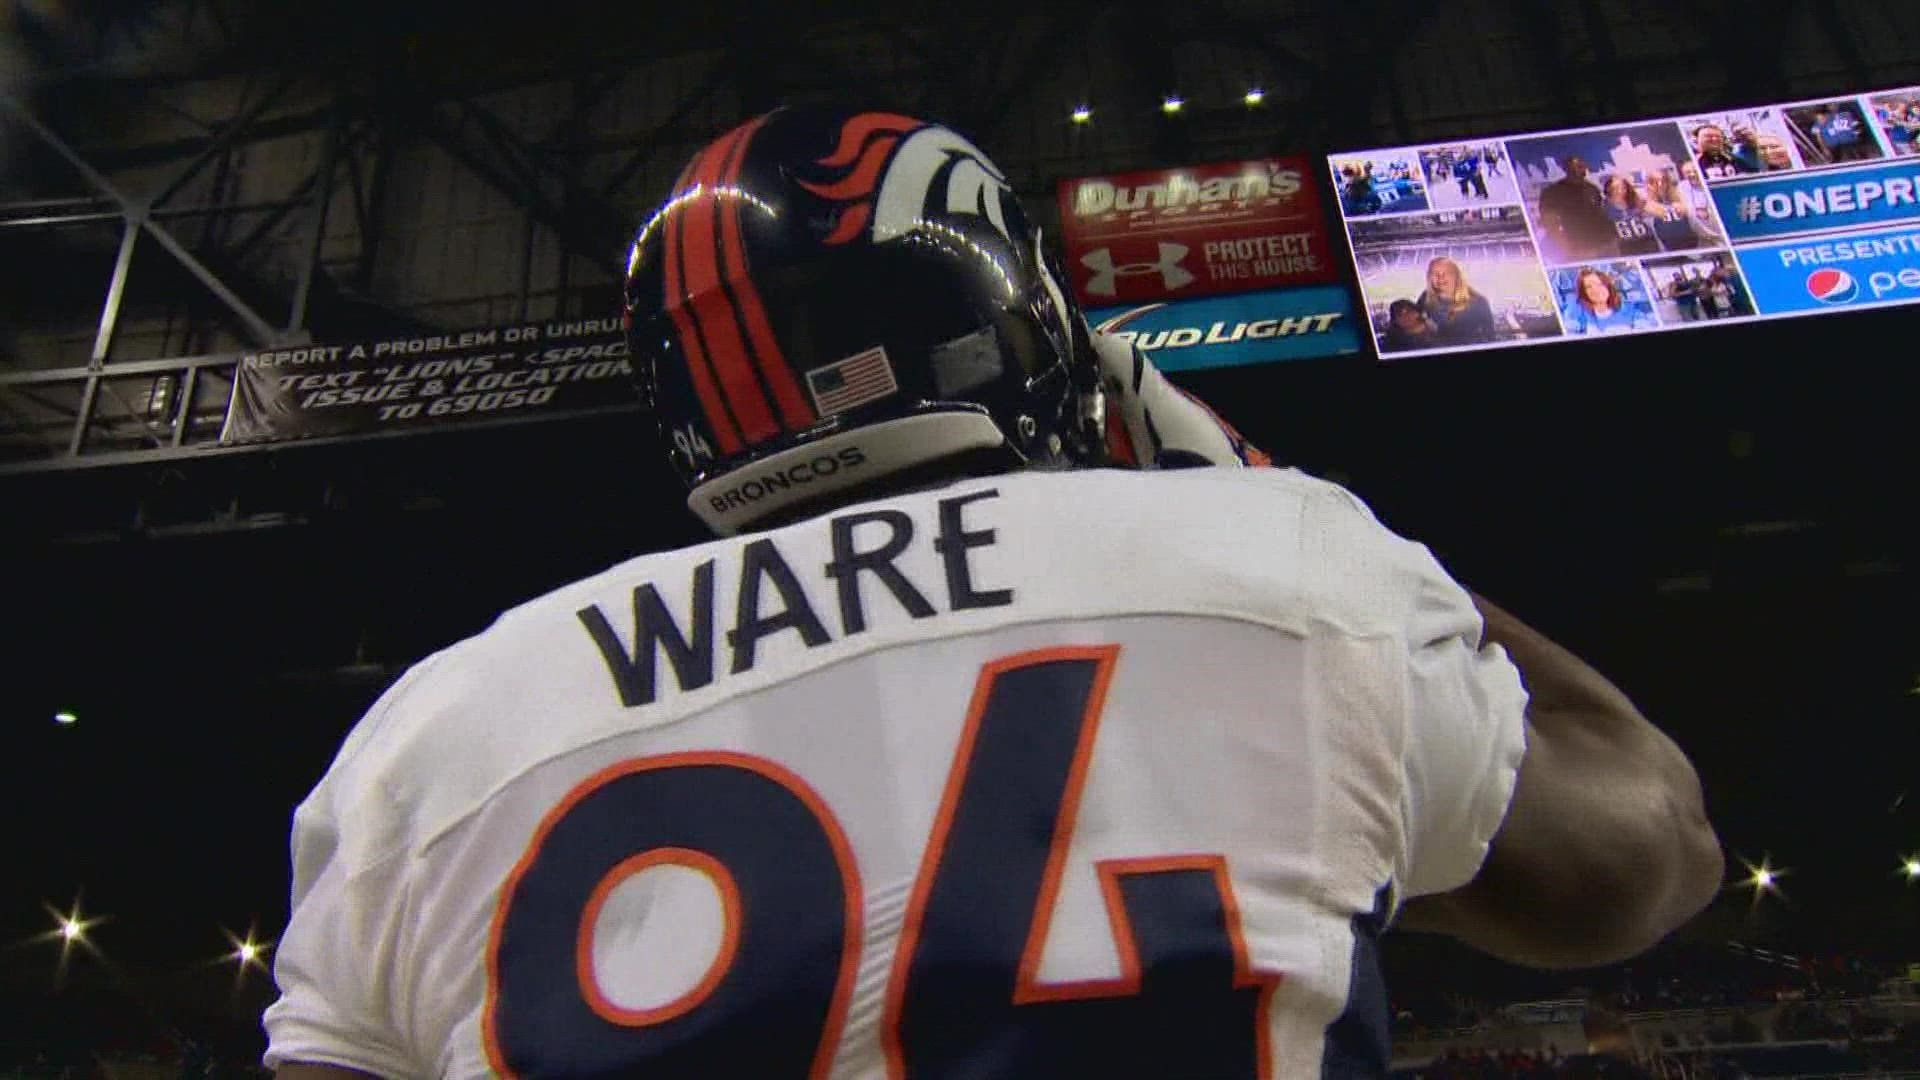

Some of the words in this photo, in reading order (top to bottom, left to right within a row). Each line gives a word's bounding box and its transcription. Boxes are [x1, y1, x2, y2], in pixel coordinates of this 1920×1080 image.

[1073, 163, 1301, 217] Dunham's
[1204, 233, 1313, 263] PROTECT
[1208, 262, 1248, 281] THIS
[243, 346, 343, 370] REPORT
[348, 344, 367, 360] A
[374, 330, 497, 357] PROBLEM
[504, 327, 538, 343] OR
[546, 317, 625, 338] UNRU
[1118, 327, 1202, 350] UD
[1204, 313, 1343, 344] LIGHT
[279, 371, 367, 391] TEXT
[525, 341, 631, 365] <SPAC
[301, 382, 417, 409] ISSUE
[418, 378, 444, 397] &
[454, 358, 633, 393] LOCATION
[379, 402, 425, 421] TO
[427, 386, 559, 416] 69050
[673, 423, 715, 469] 94
[711, 446, 866, 513] BRONCOS
[577, 489, 1016, 708] WARE
[482, 643, 1284, 1080] 94
